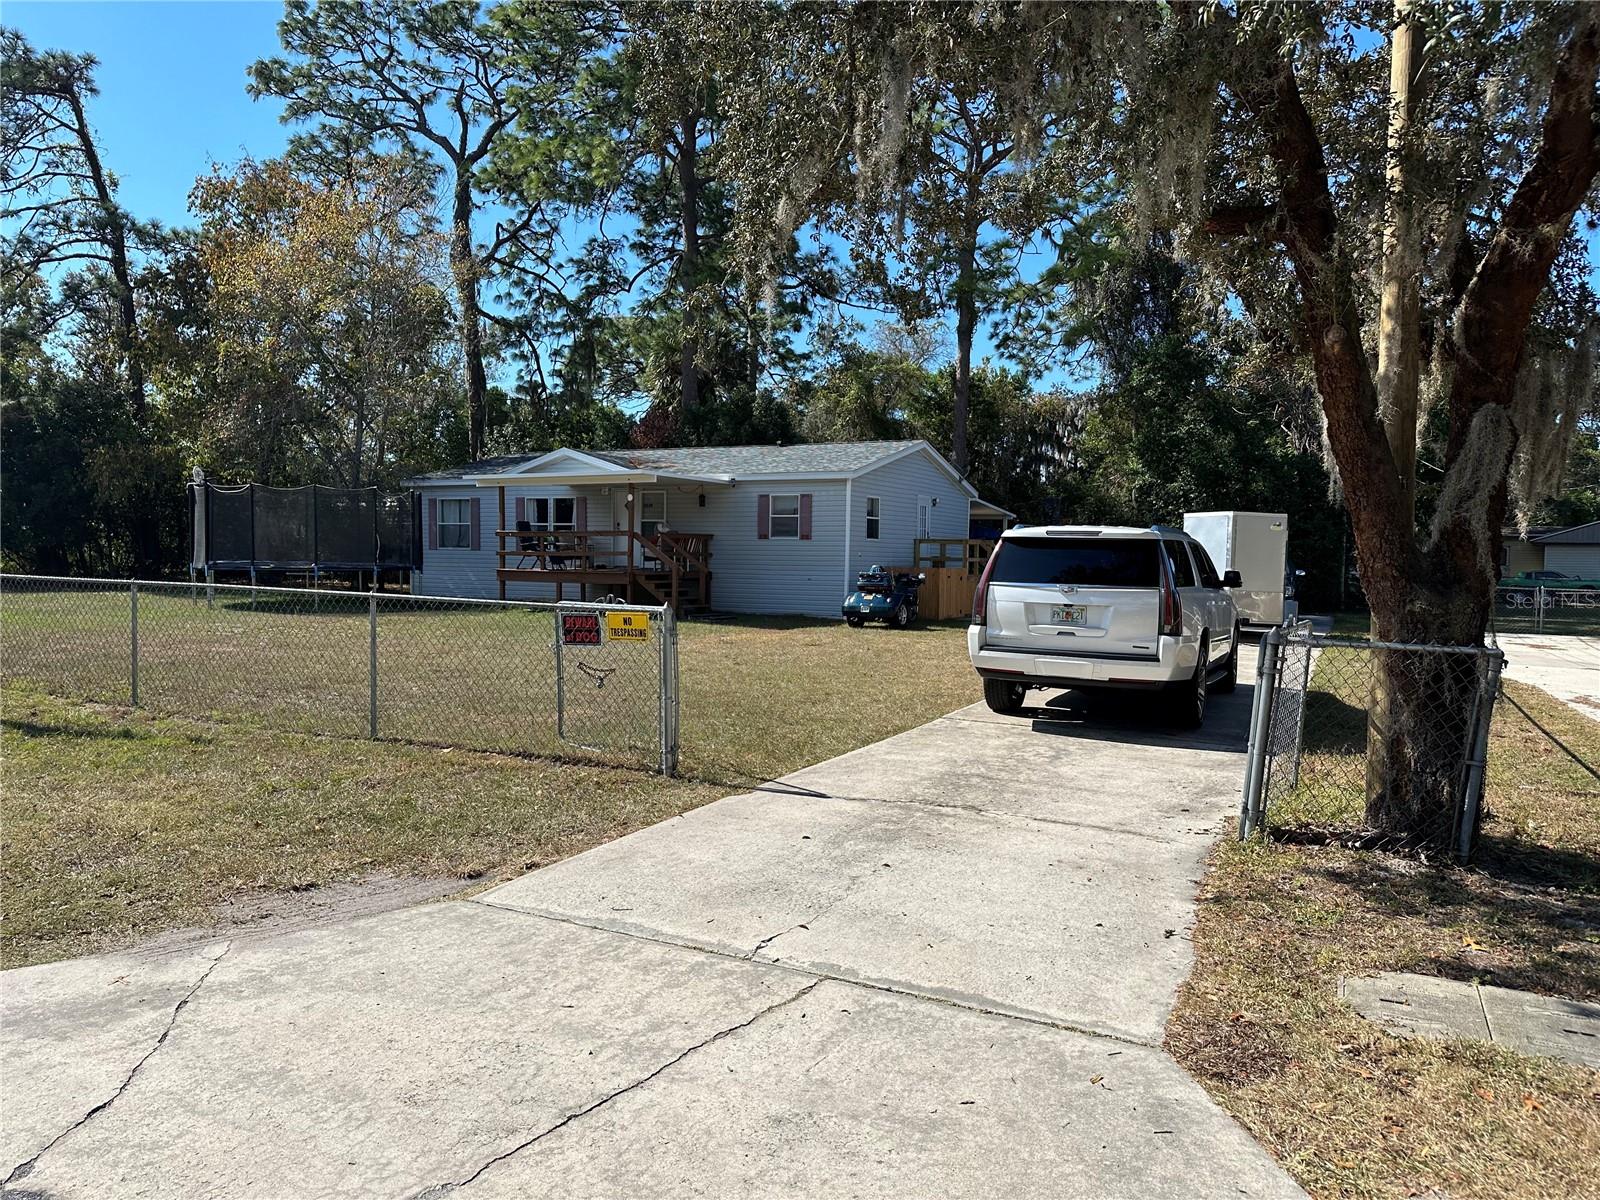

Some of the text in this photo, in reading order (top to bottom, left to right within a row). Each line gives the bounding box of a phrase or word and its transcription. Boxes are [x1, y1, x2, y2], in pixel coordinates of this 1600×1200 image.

[565, 616, 596, 628] BEWARE
[622, 616, 633, 626] NO
[575, 631, 598, 642] DOG
[610, 627, 647, 638] TRESPASSING
